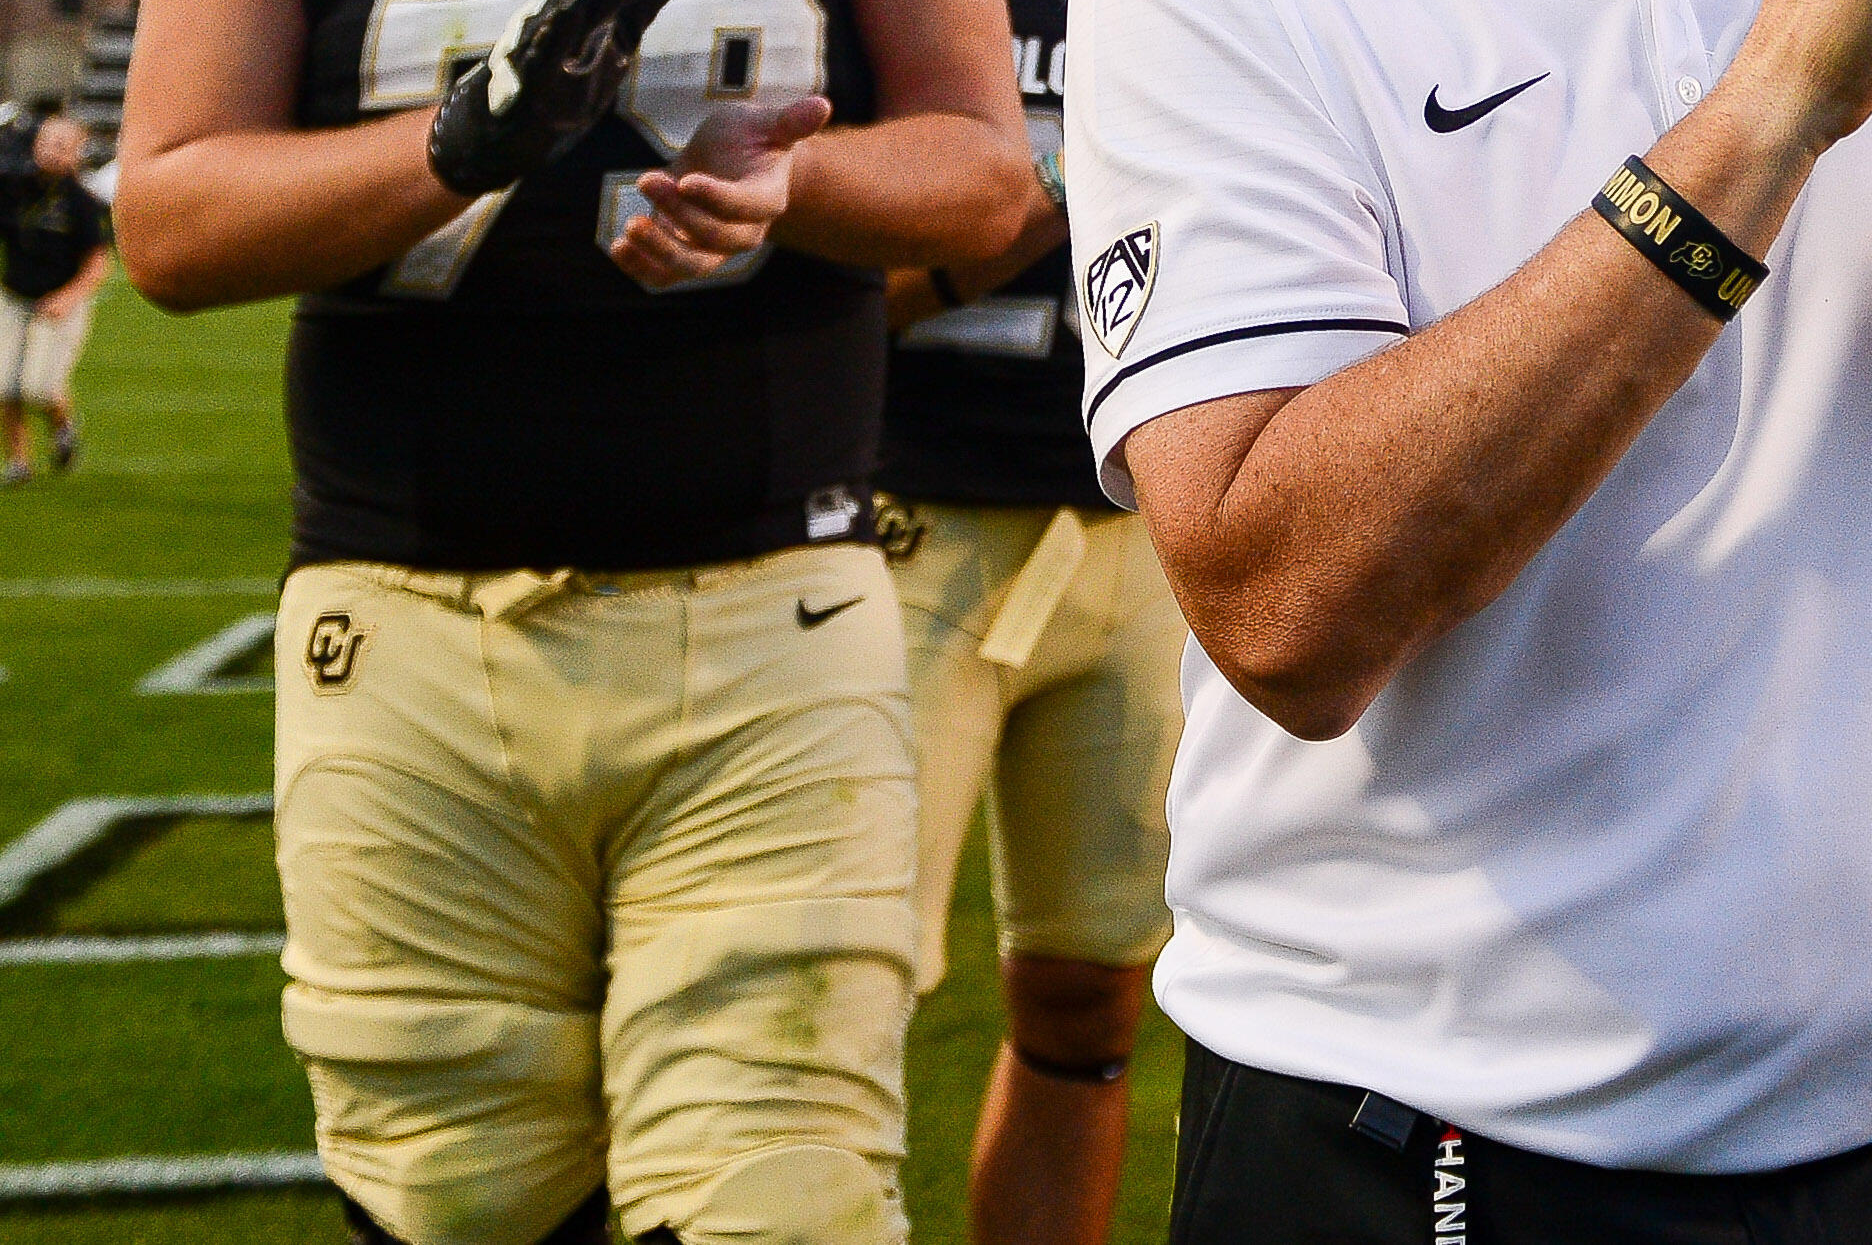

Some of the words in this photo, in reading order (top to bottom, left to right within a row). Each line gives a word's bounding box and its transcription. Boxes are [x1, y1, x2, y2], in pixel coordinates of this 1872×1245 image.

[1086, 227, 1152, 323] PAC
[1101, 279, 1135, 338] 12
[304, 609, 364, 686] CU
